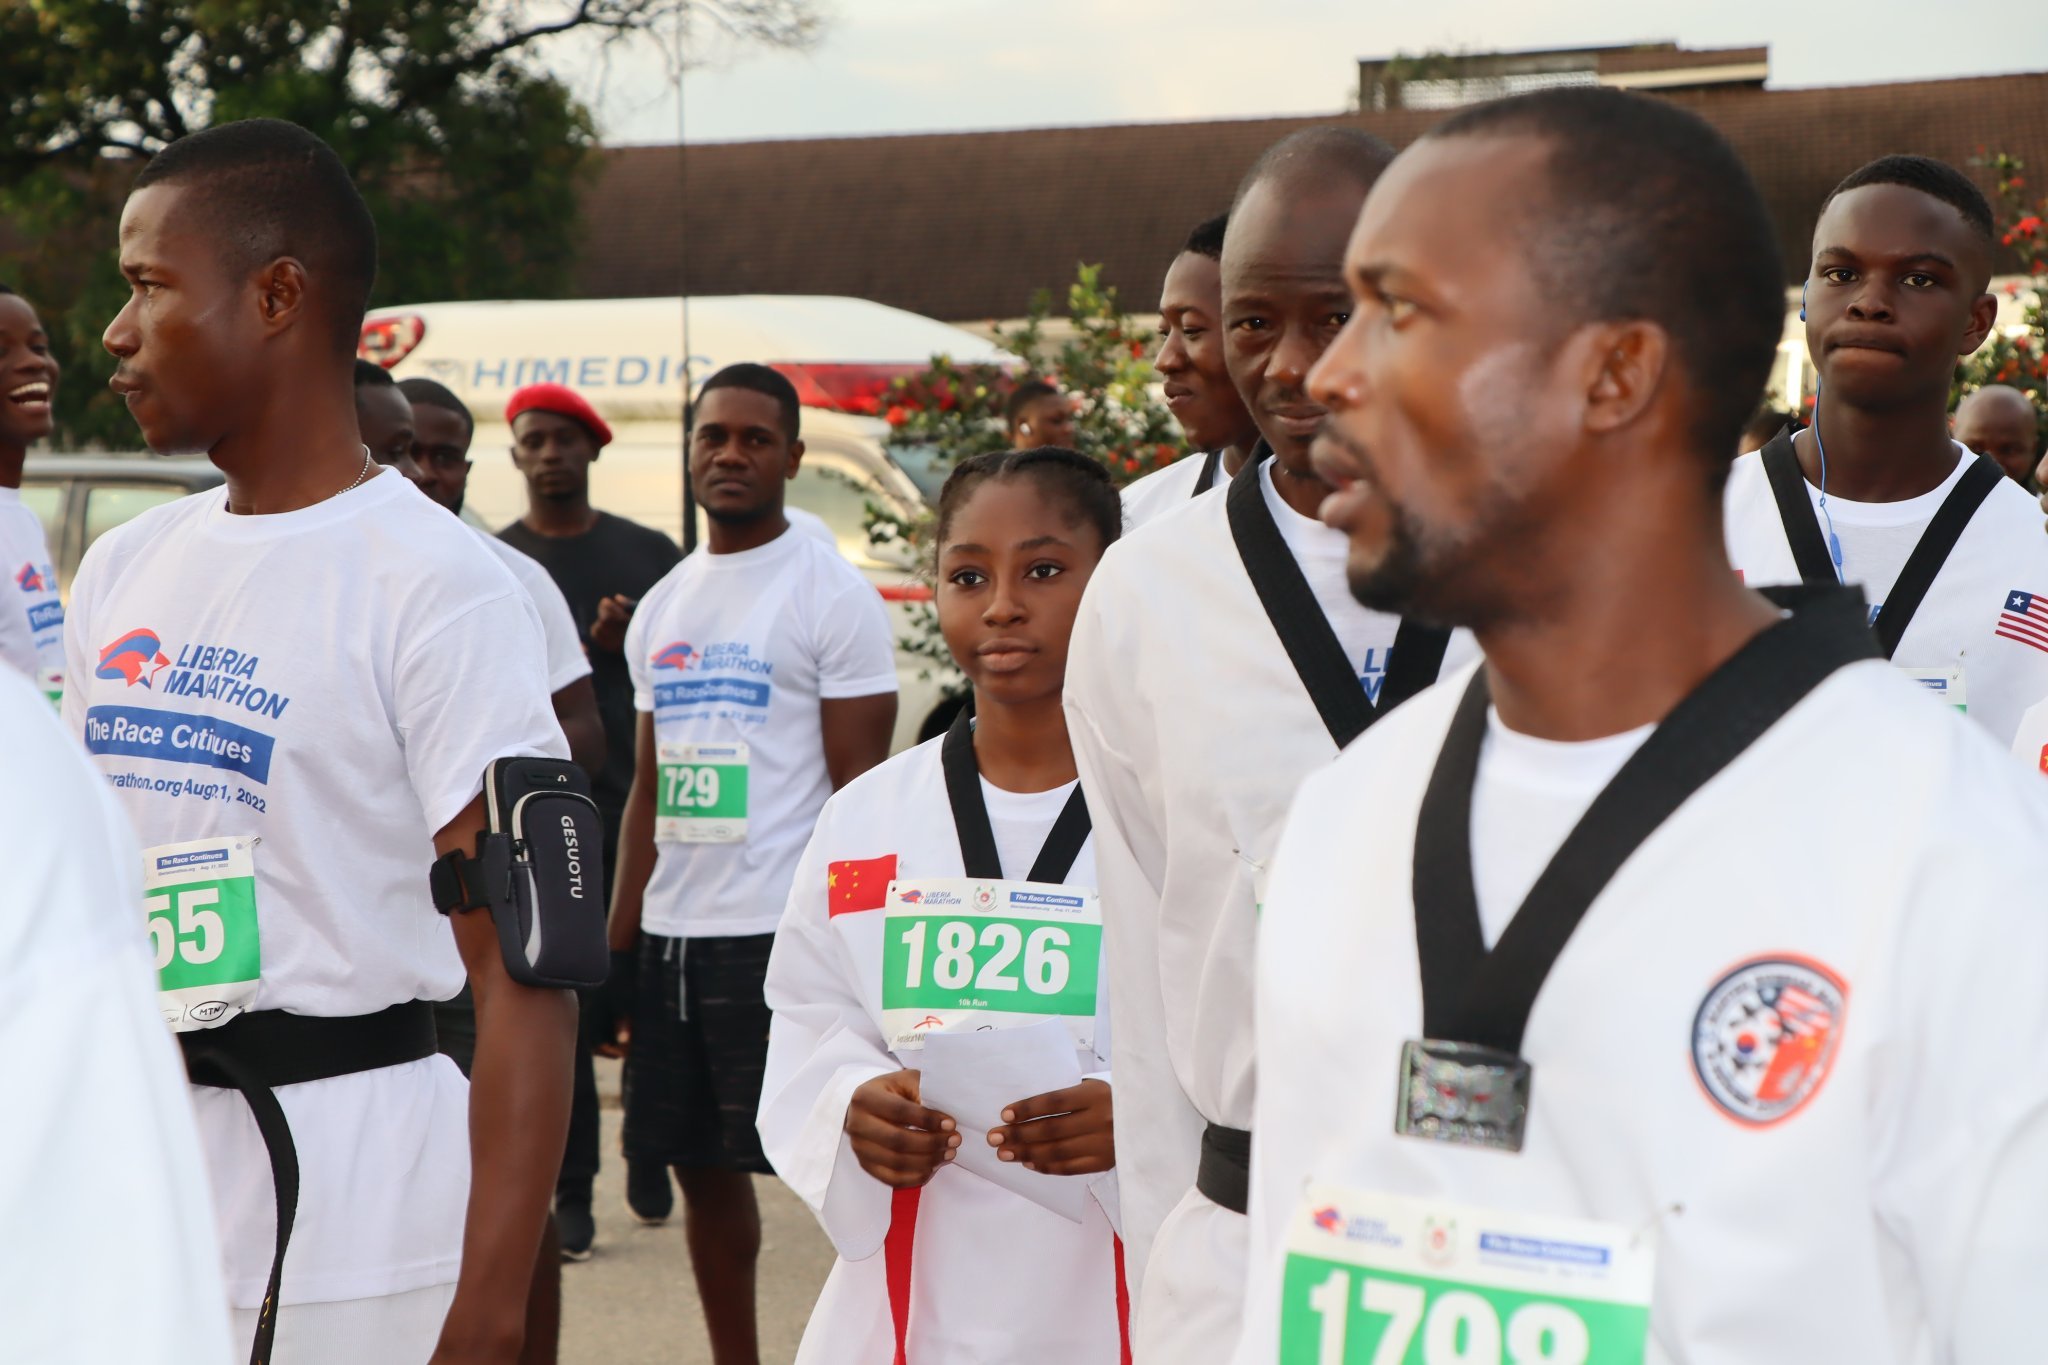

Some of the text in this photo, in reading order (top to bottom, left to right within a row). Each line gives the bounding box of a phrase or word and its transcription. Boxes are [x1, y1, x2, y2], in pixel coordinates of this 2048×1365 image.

[176, 643, 258, 680] LIBERIA
[163, 669, 289, 720] MAATHON
[88, 716, 110, 742] The
[112, 717, 164, 745] Race
[236, 788, 266, 813] 2022
[664, 766, 720, 808] 729
[173, 856, 189, 865] Race
[190, 852, 223, 862] Continues
[560, 815, 583, 899] GESUOTU
[1046, 896, 1079, 905] Continues
[901, 921, 1070, 995] 1826
[200, 1007, 220, 1016] MTN
[959, 998, 988, 1007] 10k Run
